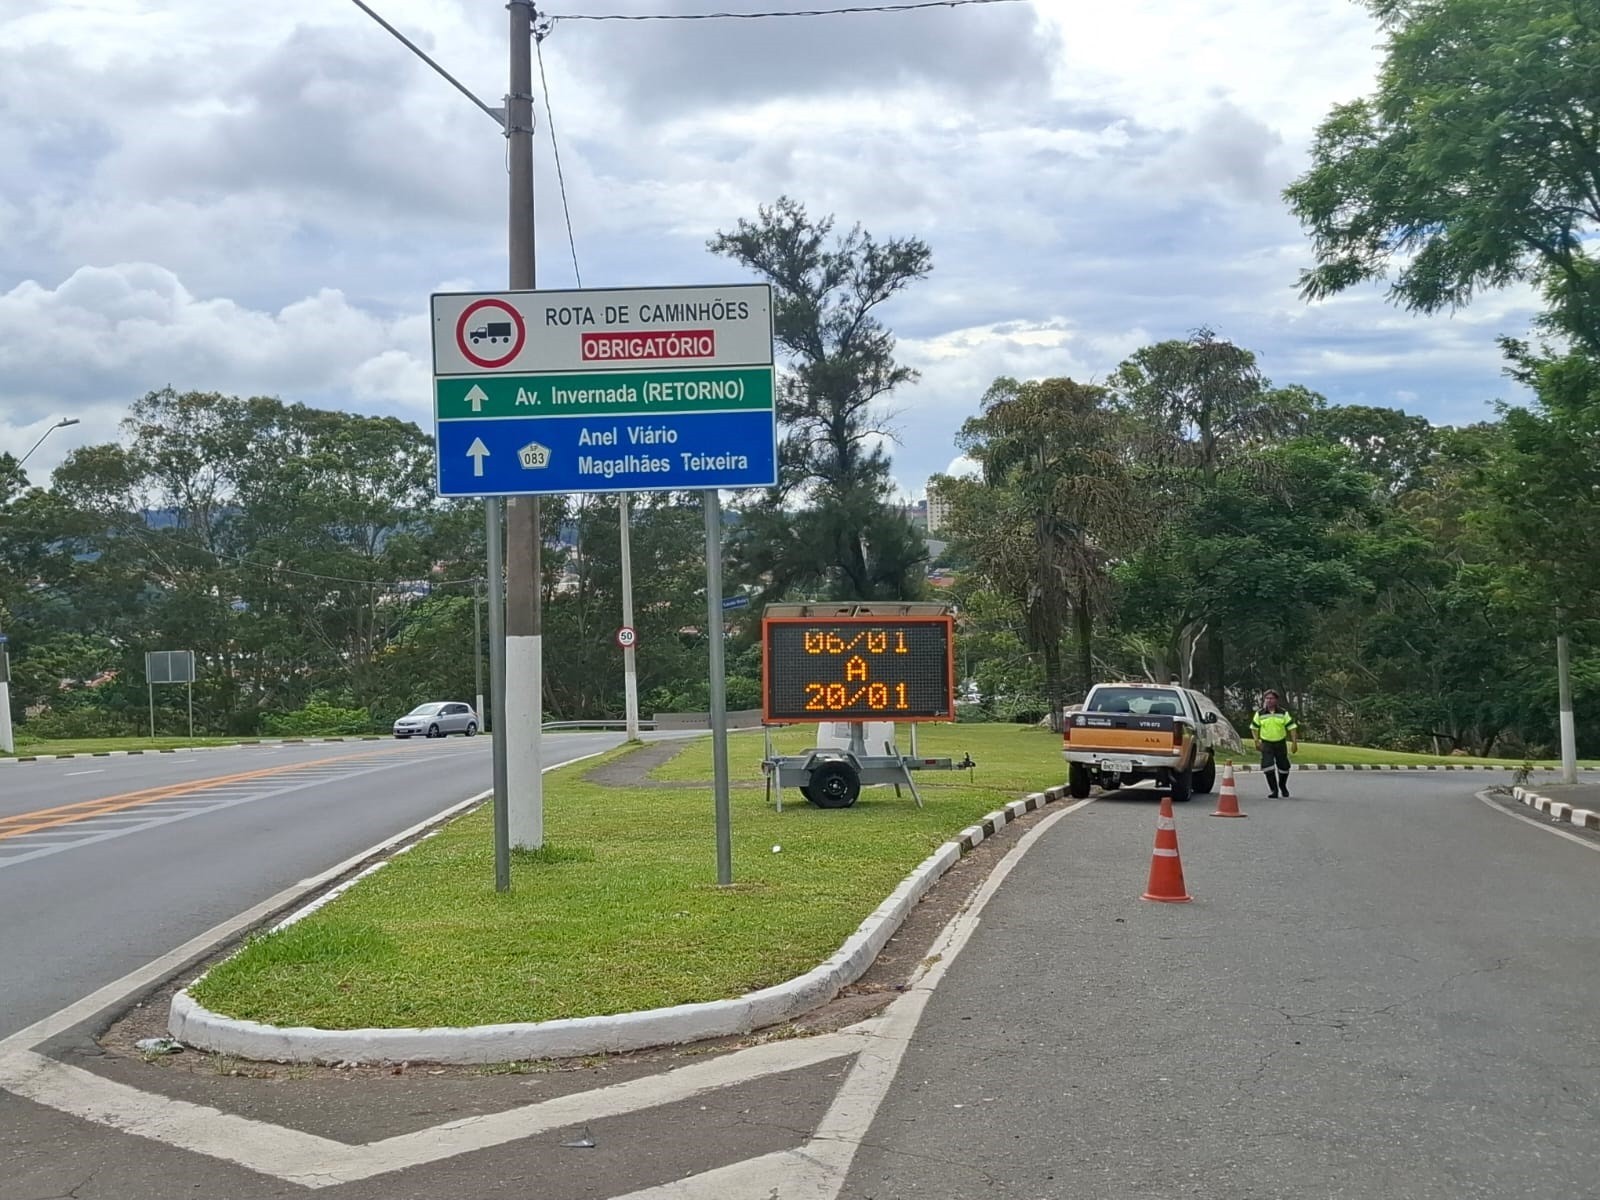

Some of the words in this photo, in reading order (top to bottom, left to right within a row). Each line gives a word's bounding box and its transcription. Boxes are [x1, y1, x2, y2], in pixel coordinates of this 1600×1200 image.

[546, 307, 595, 326] ROTA
[605, 306, 629, 324] DE
[639, 298, 749, 323] CAMINHÕES
[583, 333, 712, 358] OBRIGATÓRIO
[515, 387, 541, 405] Av.
[552, 384, 637, 404] Invernada
[642, 378, 744, 404] (RETORNO)
[578, 427, 617, 446] Anel
[627, 426, 678, 445] Viário
[524, 453, 544, 464] 083
[578, 455, 670, 478] Magalhães
[681, 452, 748, 471] Teixeira
[621, 632, 632, 640] 50
[804, 628, 909, 654] 06/01
[846, 655, 868, 681] A
[804, 682, 910, 710] 20/01
